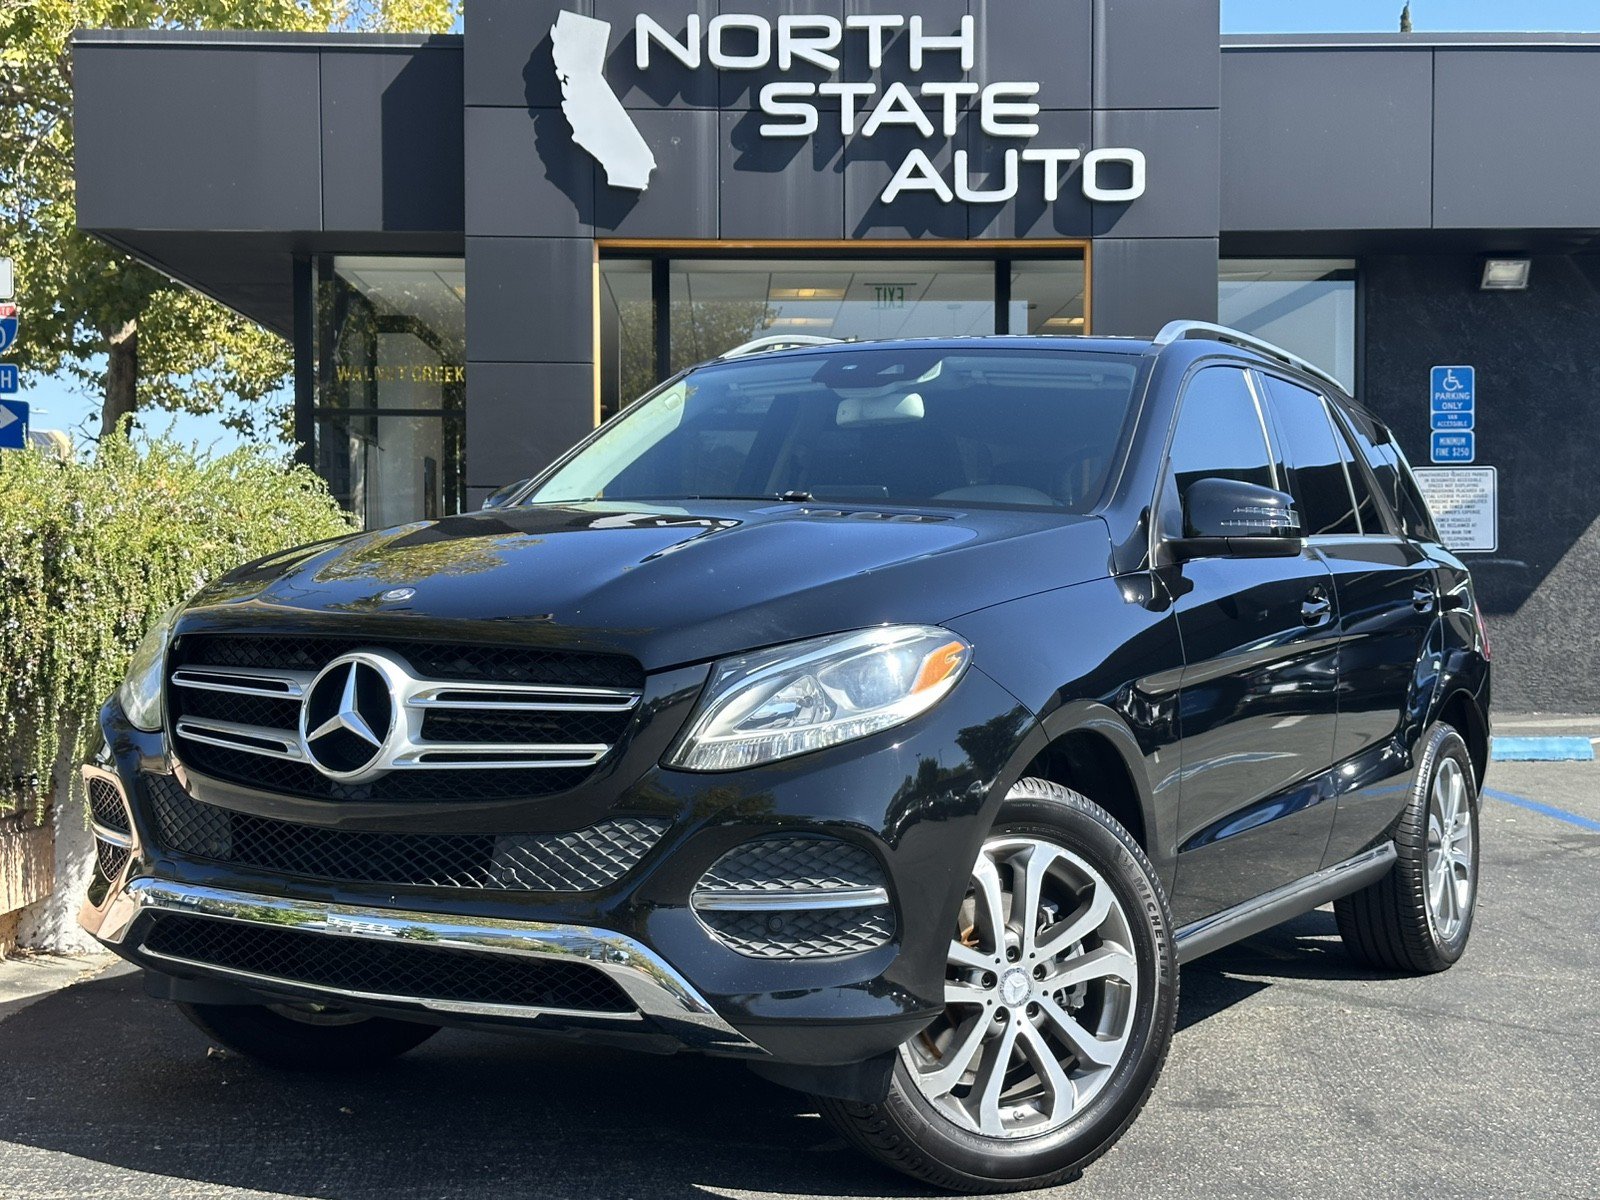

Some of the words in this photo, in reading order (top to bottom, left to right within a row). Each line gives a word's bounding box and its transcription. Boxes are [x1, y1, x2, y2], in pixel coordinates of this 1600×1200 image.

[635, 13, 974, 71] NORTH
[759, 81, 1040, 138] STATE
[880, 147, 1146, 204] AUTO
[412, 366, 465, 382] CREEK
[1435, 392, 1470, 400] PARKING
[1442, 402, 1463, 410] ONLY
[1439, 437, 1466, 446] MINIMUM
[1436, 447, 1449, 457] FINE
[1452, 447, 1470, 457] $250
[1134, 876, 1169, 979] MICHELIN
